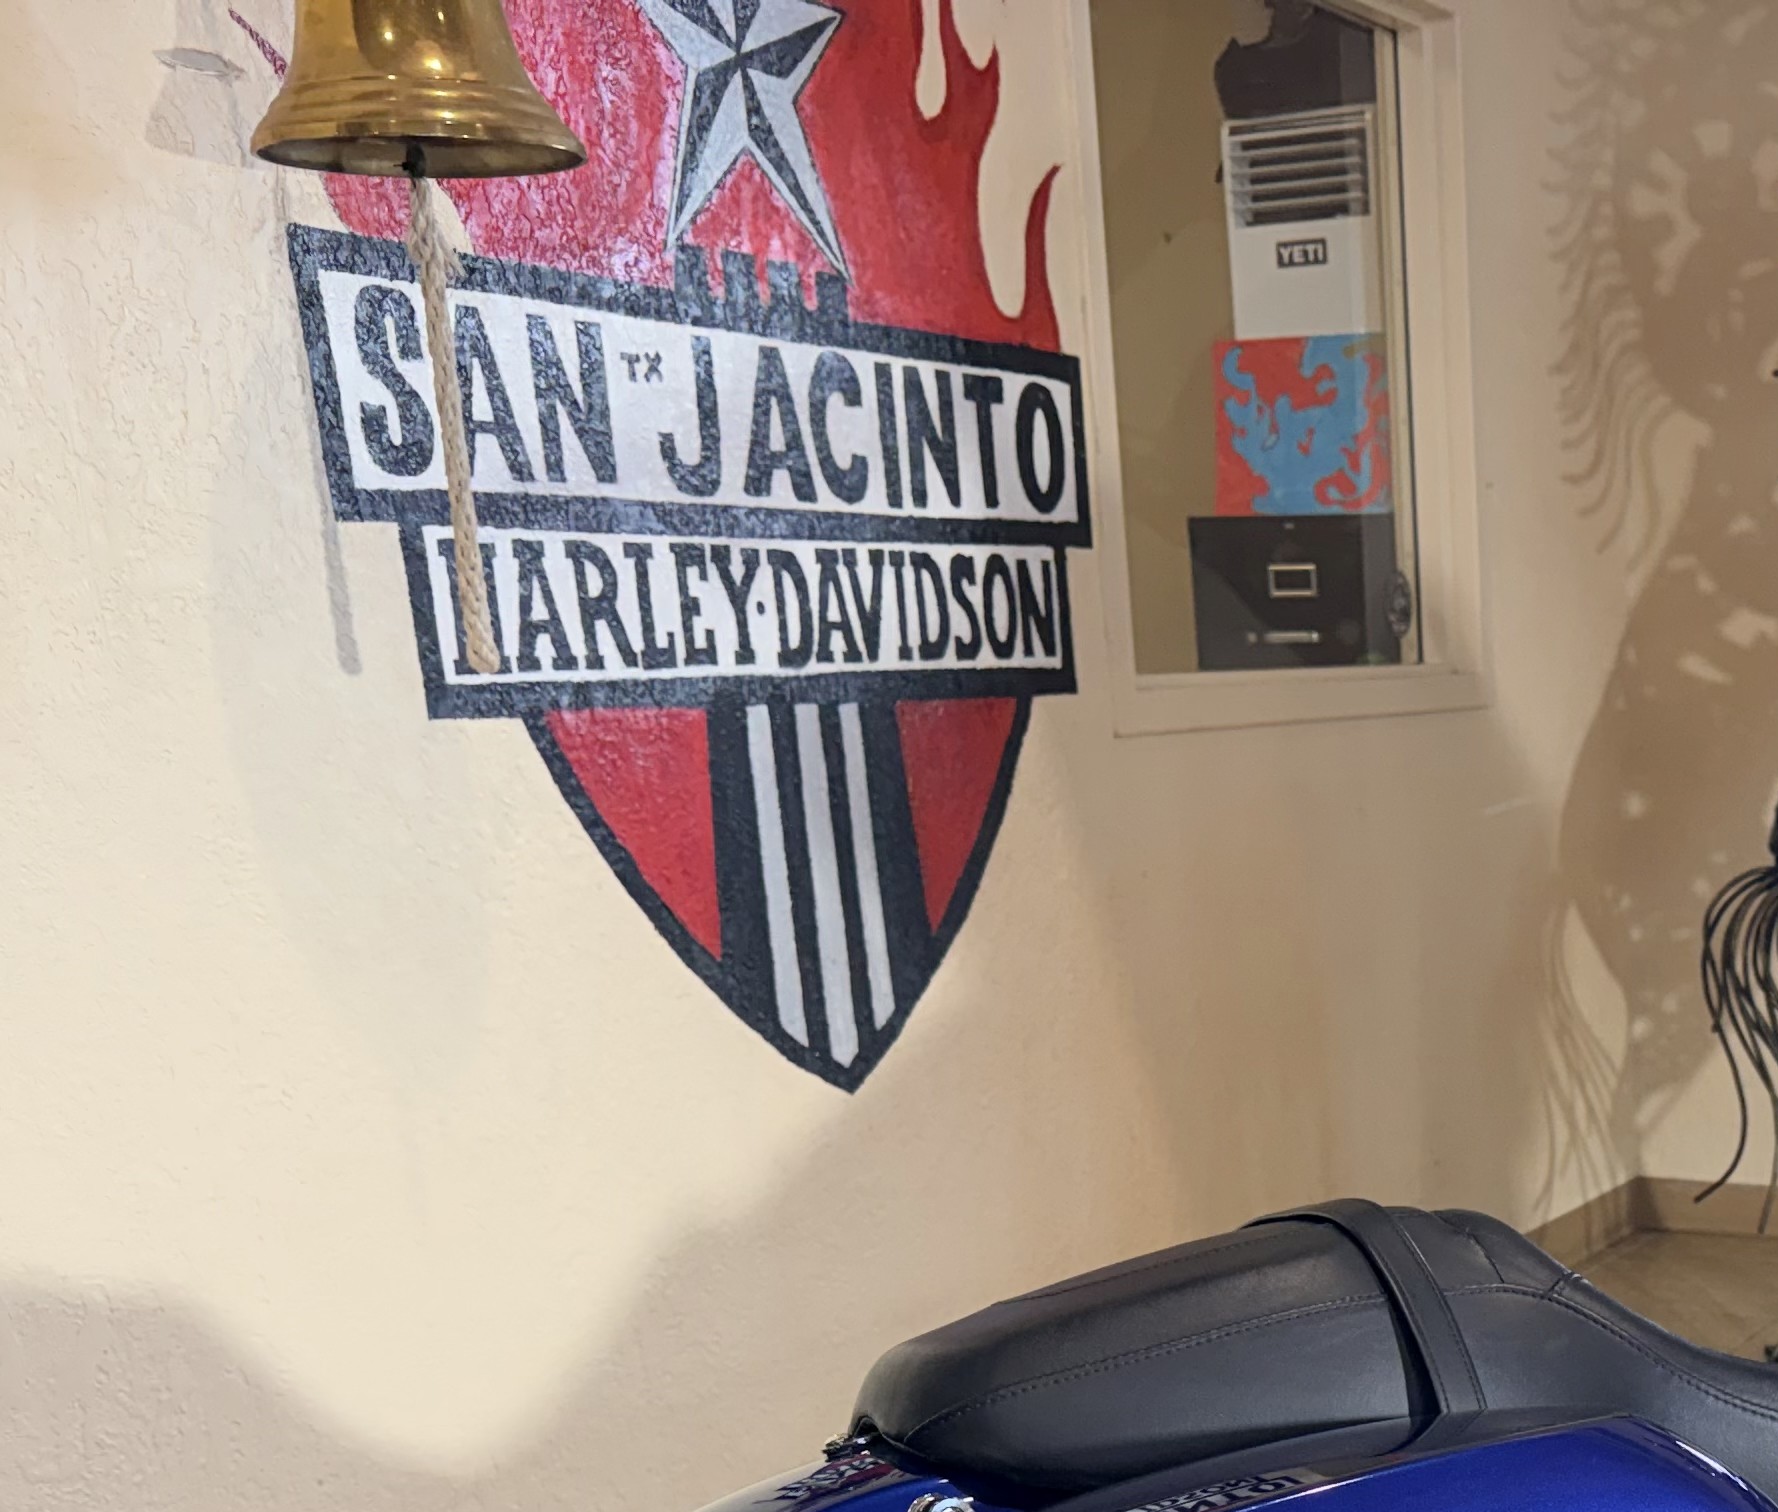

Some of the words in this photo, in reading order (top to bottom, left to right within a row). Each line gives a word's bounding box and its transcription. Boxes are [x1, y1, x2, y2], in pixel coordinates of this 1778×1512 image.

[1280, 243, 1323, 265] YETI
[354, 284, 618, 483] SAN
[619, 351, 664, 383] TX
[659, 335, 1067, 515] JACINTO
